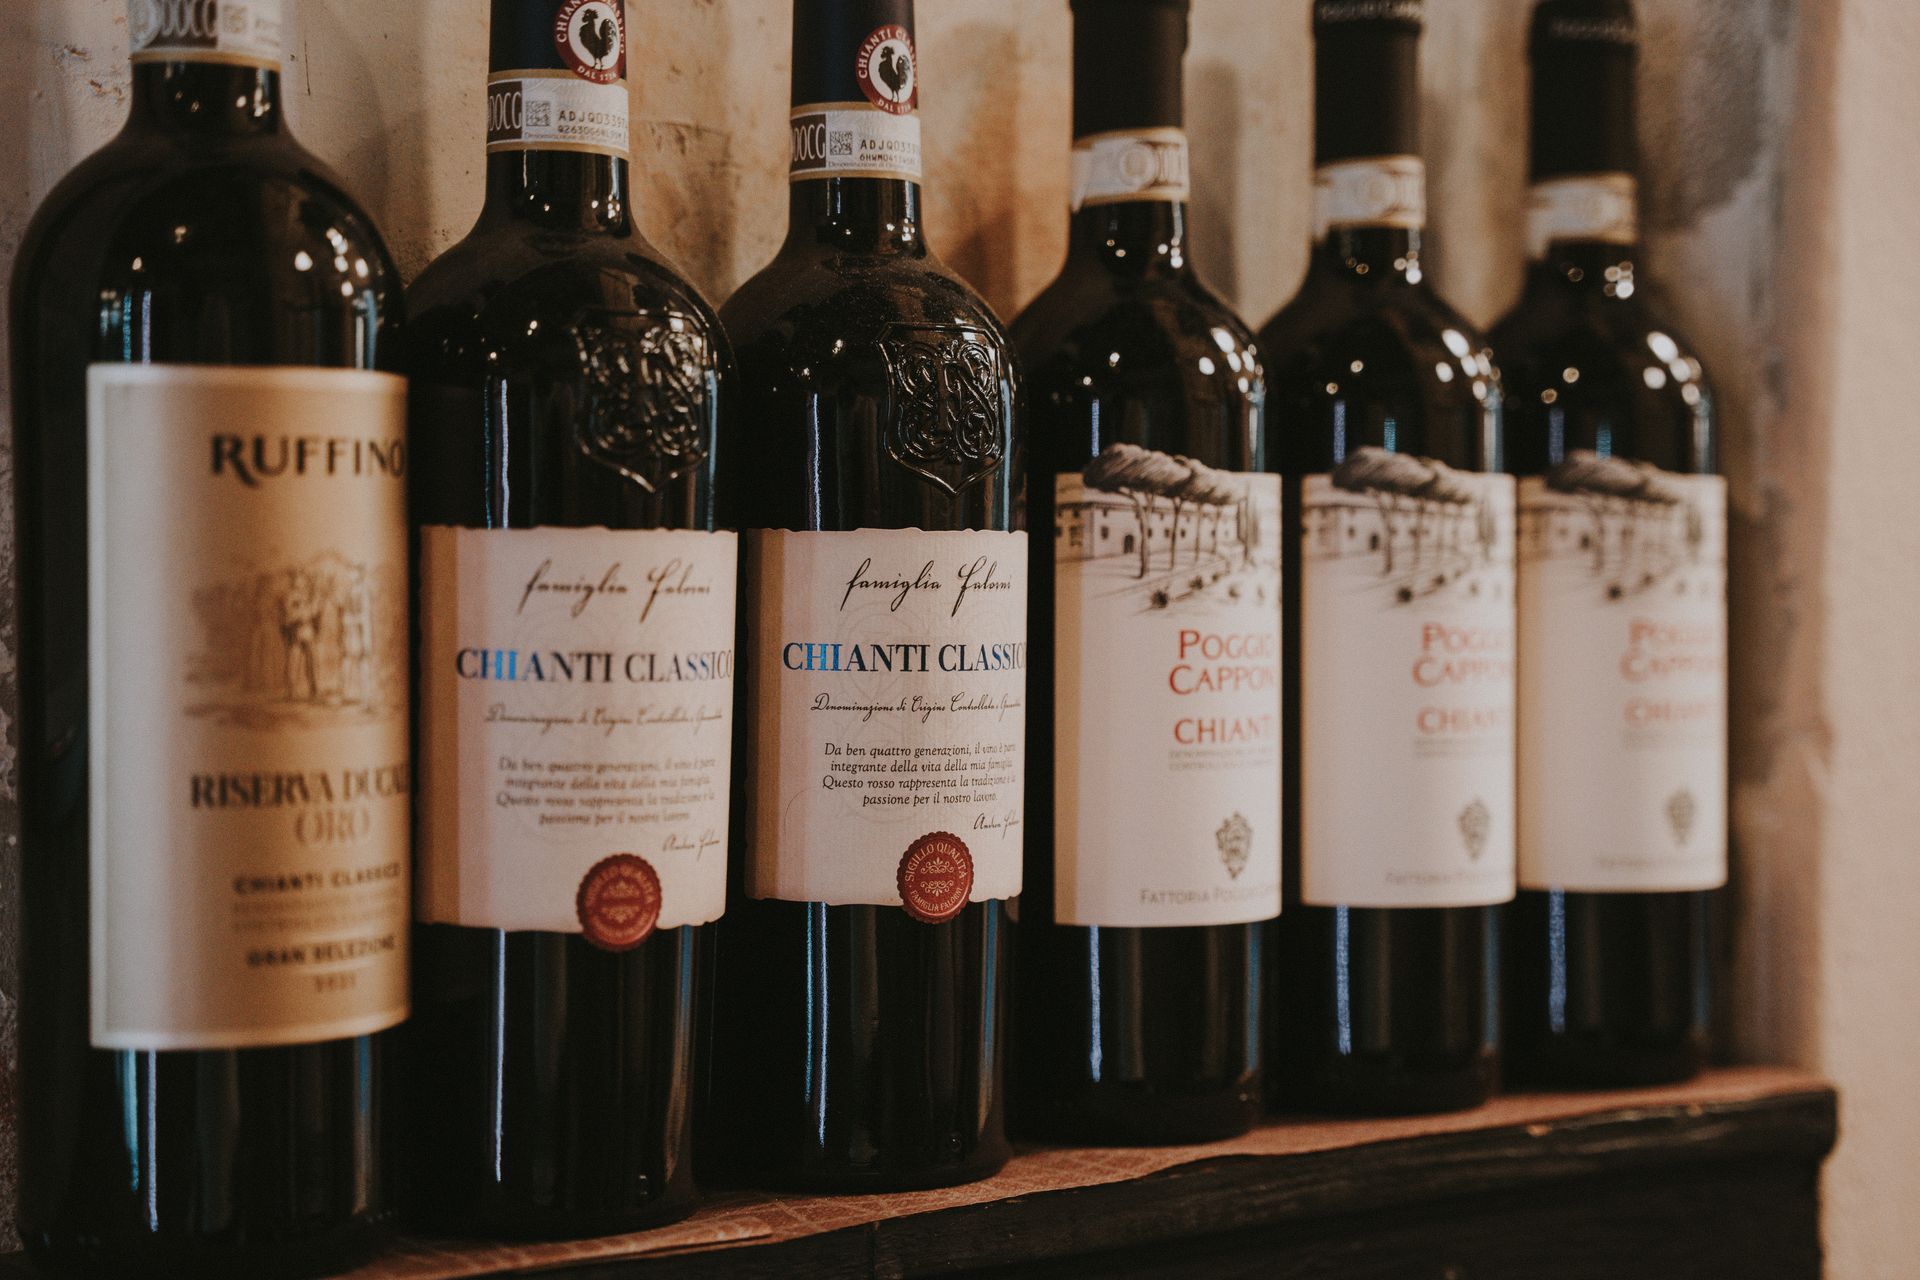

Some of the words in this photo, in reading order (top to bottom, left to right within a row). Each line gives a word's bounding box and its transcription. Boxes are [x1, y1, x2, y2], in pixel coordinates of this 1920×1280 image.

[556, 0, 589, 42] CHIAN
[858, 29, 891, 79] CHIANTI
[577, 66, 596, 79] DAL
[878, 98, 894, 113] DAL
[210, 433, 405, 488] RUFFINO
[840, 557, 942, 612] famiglia
[456, 648, 612, 683] CHIANTI
[626, 649, 733, 682] CLASSICO
[783, 642, 930, 672] CHIANTI
[1169, 665, 1275, 695] CAPPON
[811, 692, 894, 722] Denominazione
[896, 697, 906, 711] di
[912, 696, 946, 723] Origine
[1174, 716, 1272, 746] CHIANT
[824, 743, 842, 756] Da
[846, 743, 865, 756] ben
[870, 744, 912, 758] quattro
[914, 744, 972, 758] generazioni,
[974, 742, 981, 755] il
[831, 761, 887, 773] integrante
[890, 759, 918, 773] della
[921, 760, 941, 772] vita
[944, 758, 967, 772] della
[970, 760, 986, 771] mia
[190, 771, 334, 809] RISERVA
[823, 775, 864, 790] Questo
[867, 778, 895, 789] rosso
[899, 777, 957, 790] rappresenta
[960, 774, 969, 788] la
[863, 795, 910, 807] passione
[913, 796, 929, 807] per
[933, 792, 940, 804] il
[943, 793, 970, 804] nostro
[905, 843, 935, 882] SIGILLO
[910, 889, 939, 912] FAMIGLIA
